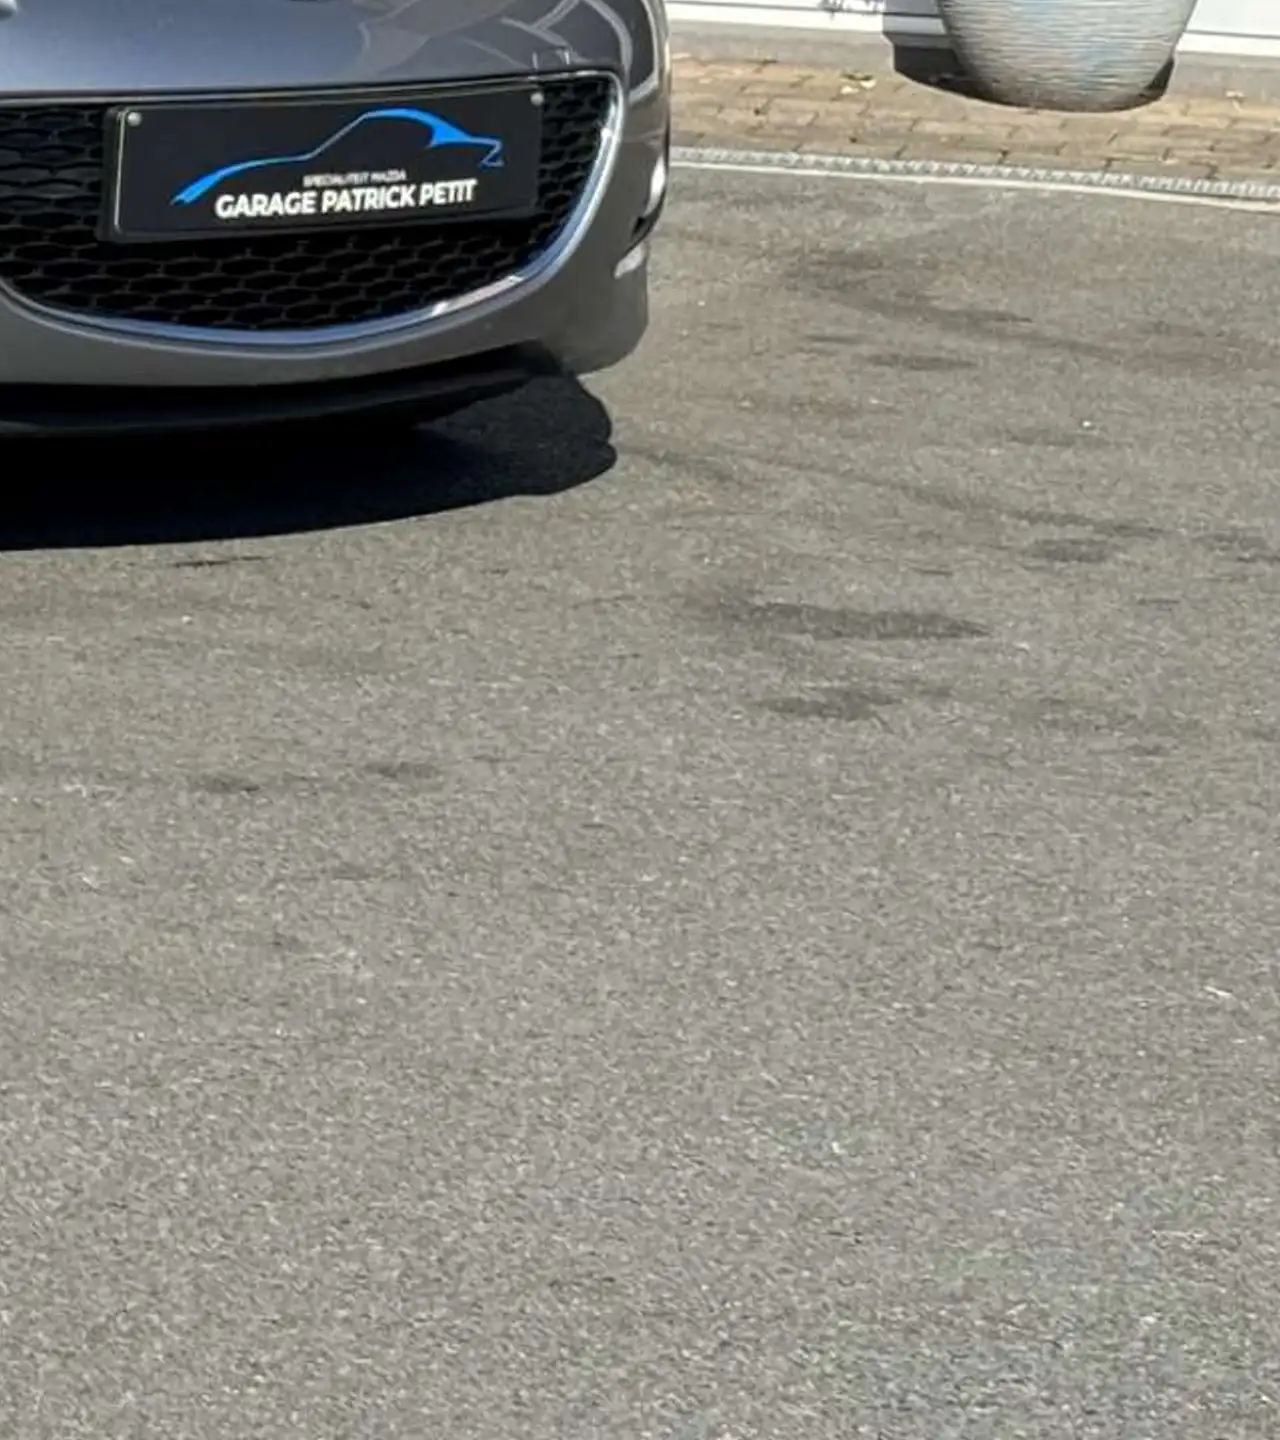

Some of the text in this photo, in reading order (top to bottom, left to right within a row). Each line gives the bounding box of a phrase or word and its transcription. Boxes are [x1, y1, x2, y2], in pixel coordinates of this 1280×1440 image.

[214, 178, 478, 219] GARAGE PATRICK PETIT
